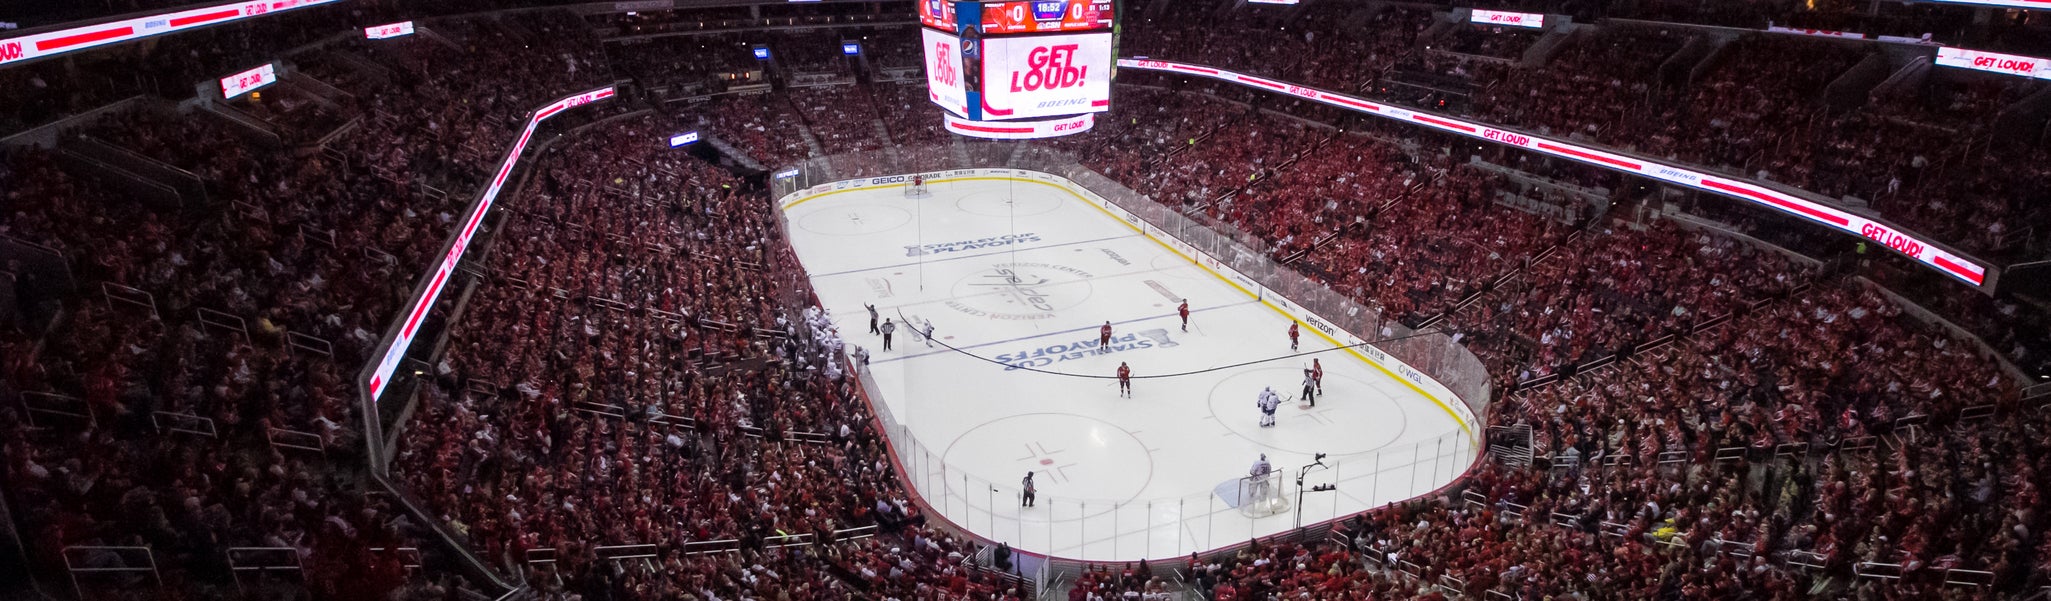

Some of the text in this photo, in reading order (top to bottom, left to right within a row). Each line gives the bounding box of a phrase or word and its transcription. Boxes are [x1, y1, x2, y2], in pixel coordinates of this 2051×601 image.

[1013, 5, 1024, 22] 0
[1037, 3, 1060, 12] 18:52
[1072, 3, 1082, 20] 0
[936, 42, 950, 61] GET
[1028, 44, 1078, 68] GET
[1973, 56, 2035, 72] GET LOUD!
[934, 61, 957, 88] LOUD!
[1010, 65, 1087, 92] LOUD!
[1289, 85, 1317, 98] GET LOUD!
[1037, 97, 1087, 108] BOEING
[1054, 120, 1085, 132] GET LOUD!
[1484, 129, 1530, 146] GET LOUD!
[872, 176, 905, 185] GEICO
[1660, 168, 1697, 181] BOEING
[923, 232, 1035, 249] STANLEY CUP
[933, 236, 1041, 254] PLAYOFFS
[1861, 222, 1924, 259] GET LOUD!
[1305, 313, 1335, 336] verizon
[995, 333, 1137, 362] PLAYOFFS
[1004, 357, 1050, 371] CUP
[1405, 369, 1423, 385] WGL
